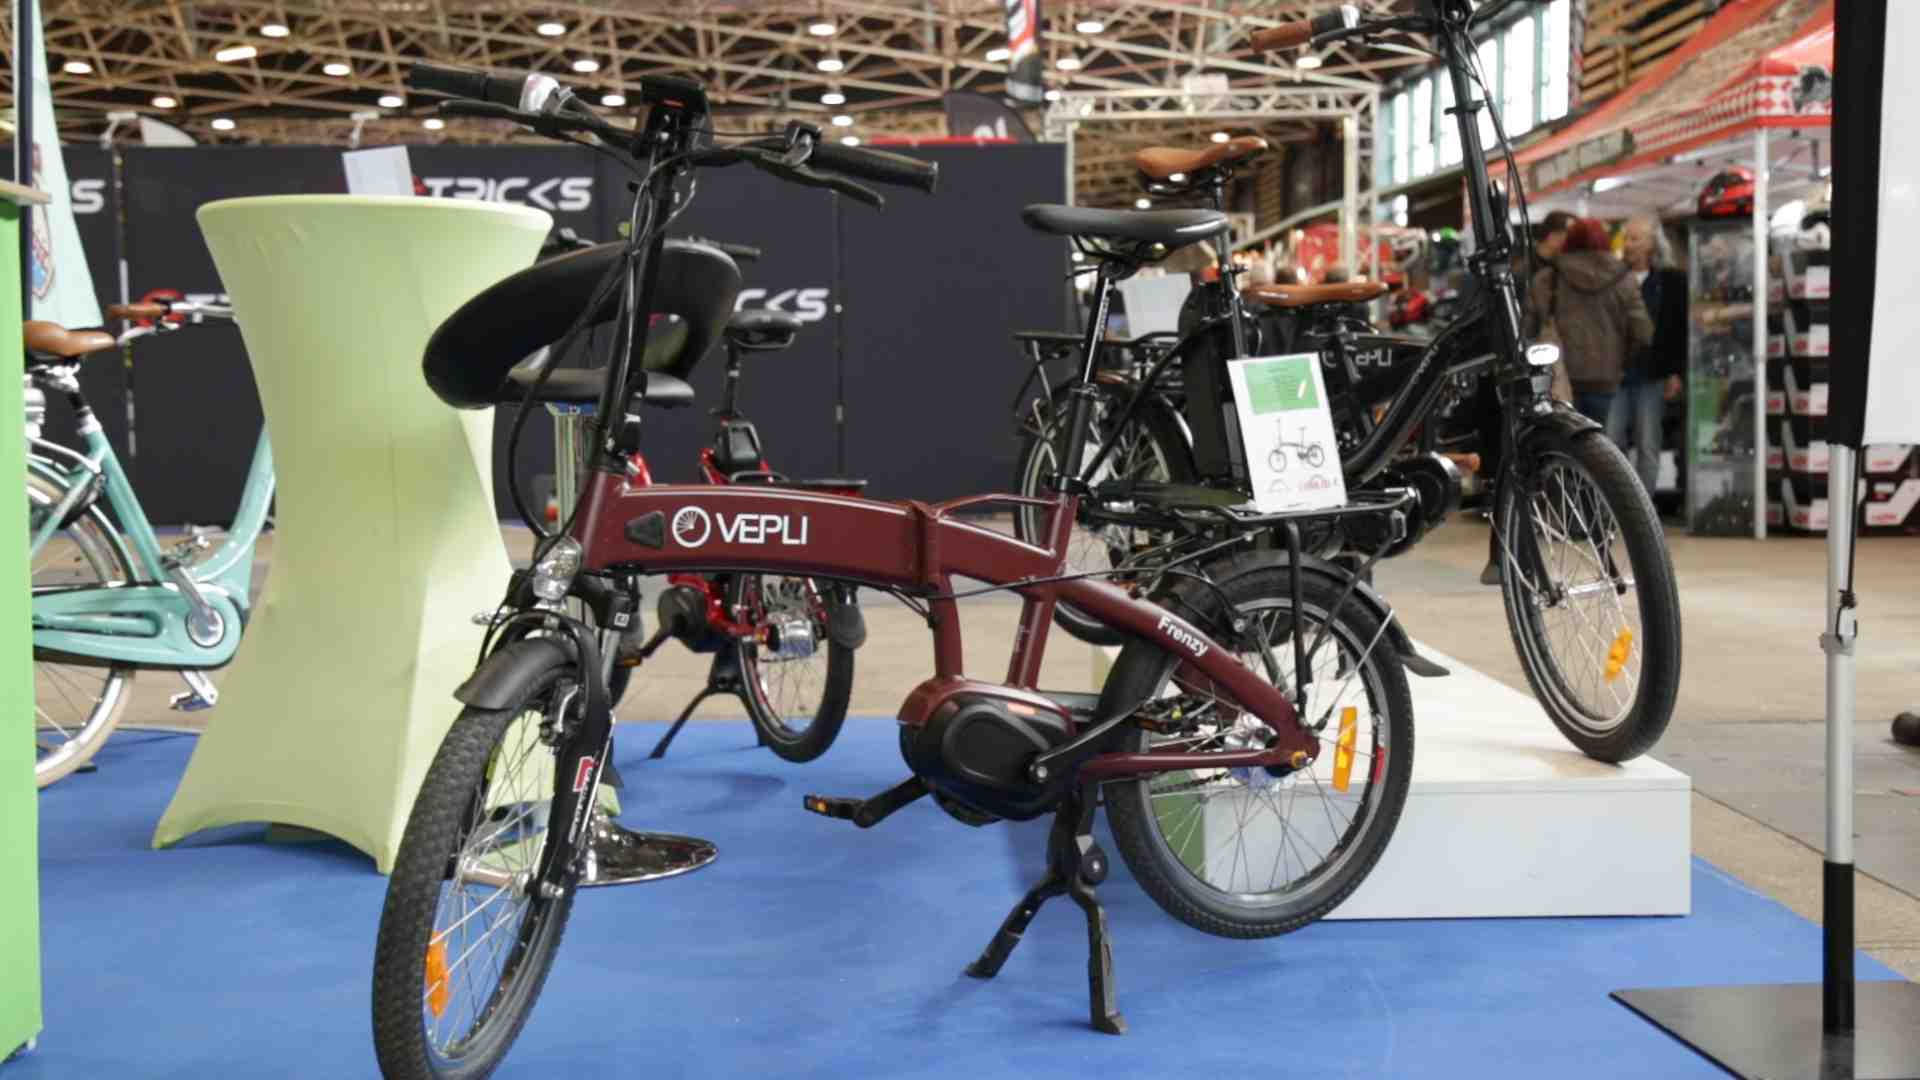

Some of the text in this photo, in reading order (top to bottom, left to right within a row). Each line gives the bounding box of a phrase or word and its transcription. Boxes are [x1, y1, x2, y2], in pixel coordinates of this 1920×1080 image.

[734, 288, 829, 321] CKS
[715, 512, 808, 545] VEPLI
[1157, 616, 1209, 657] Frenzy
